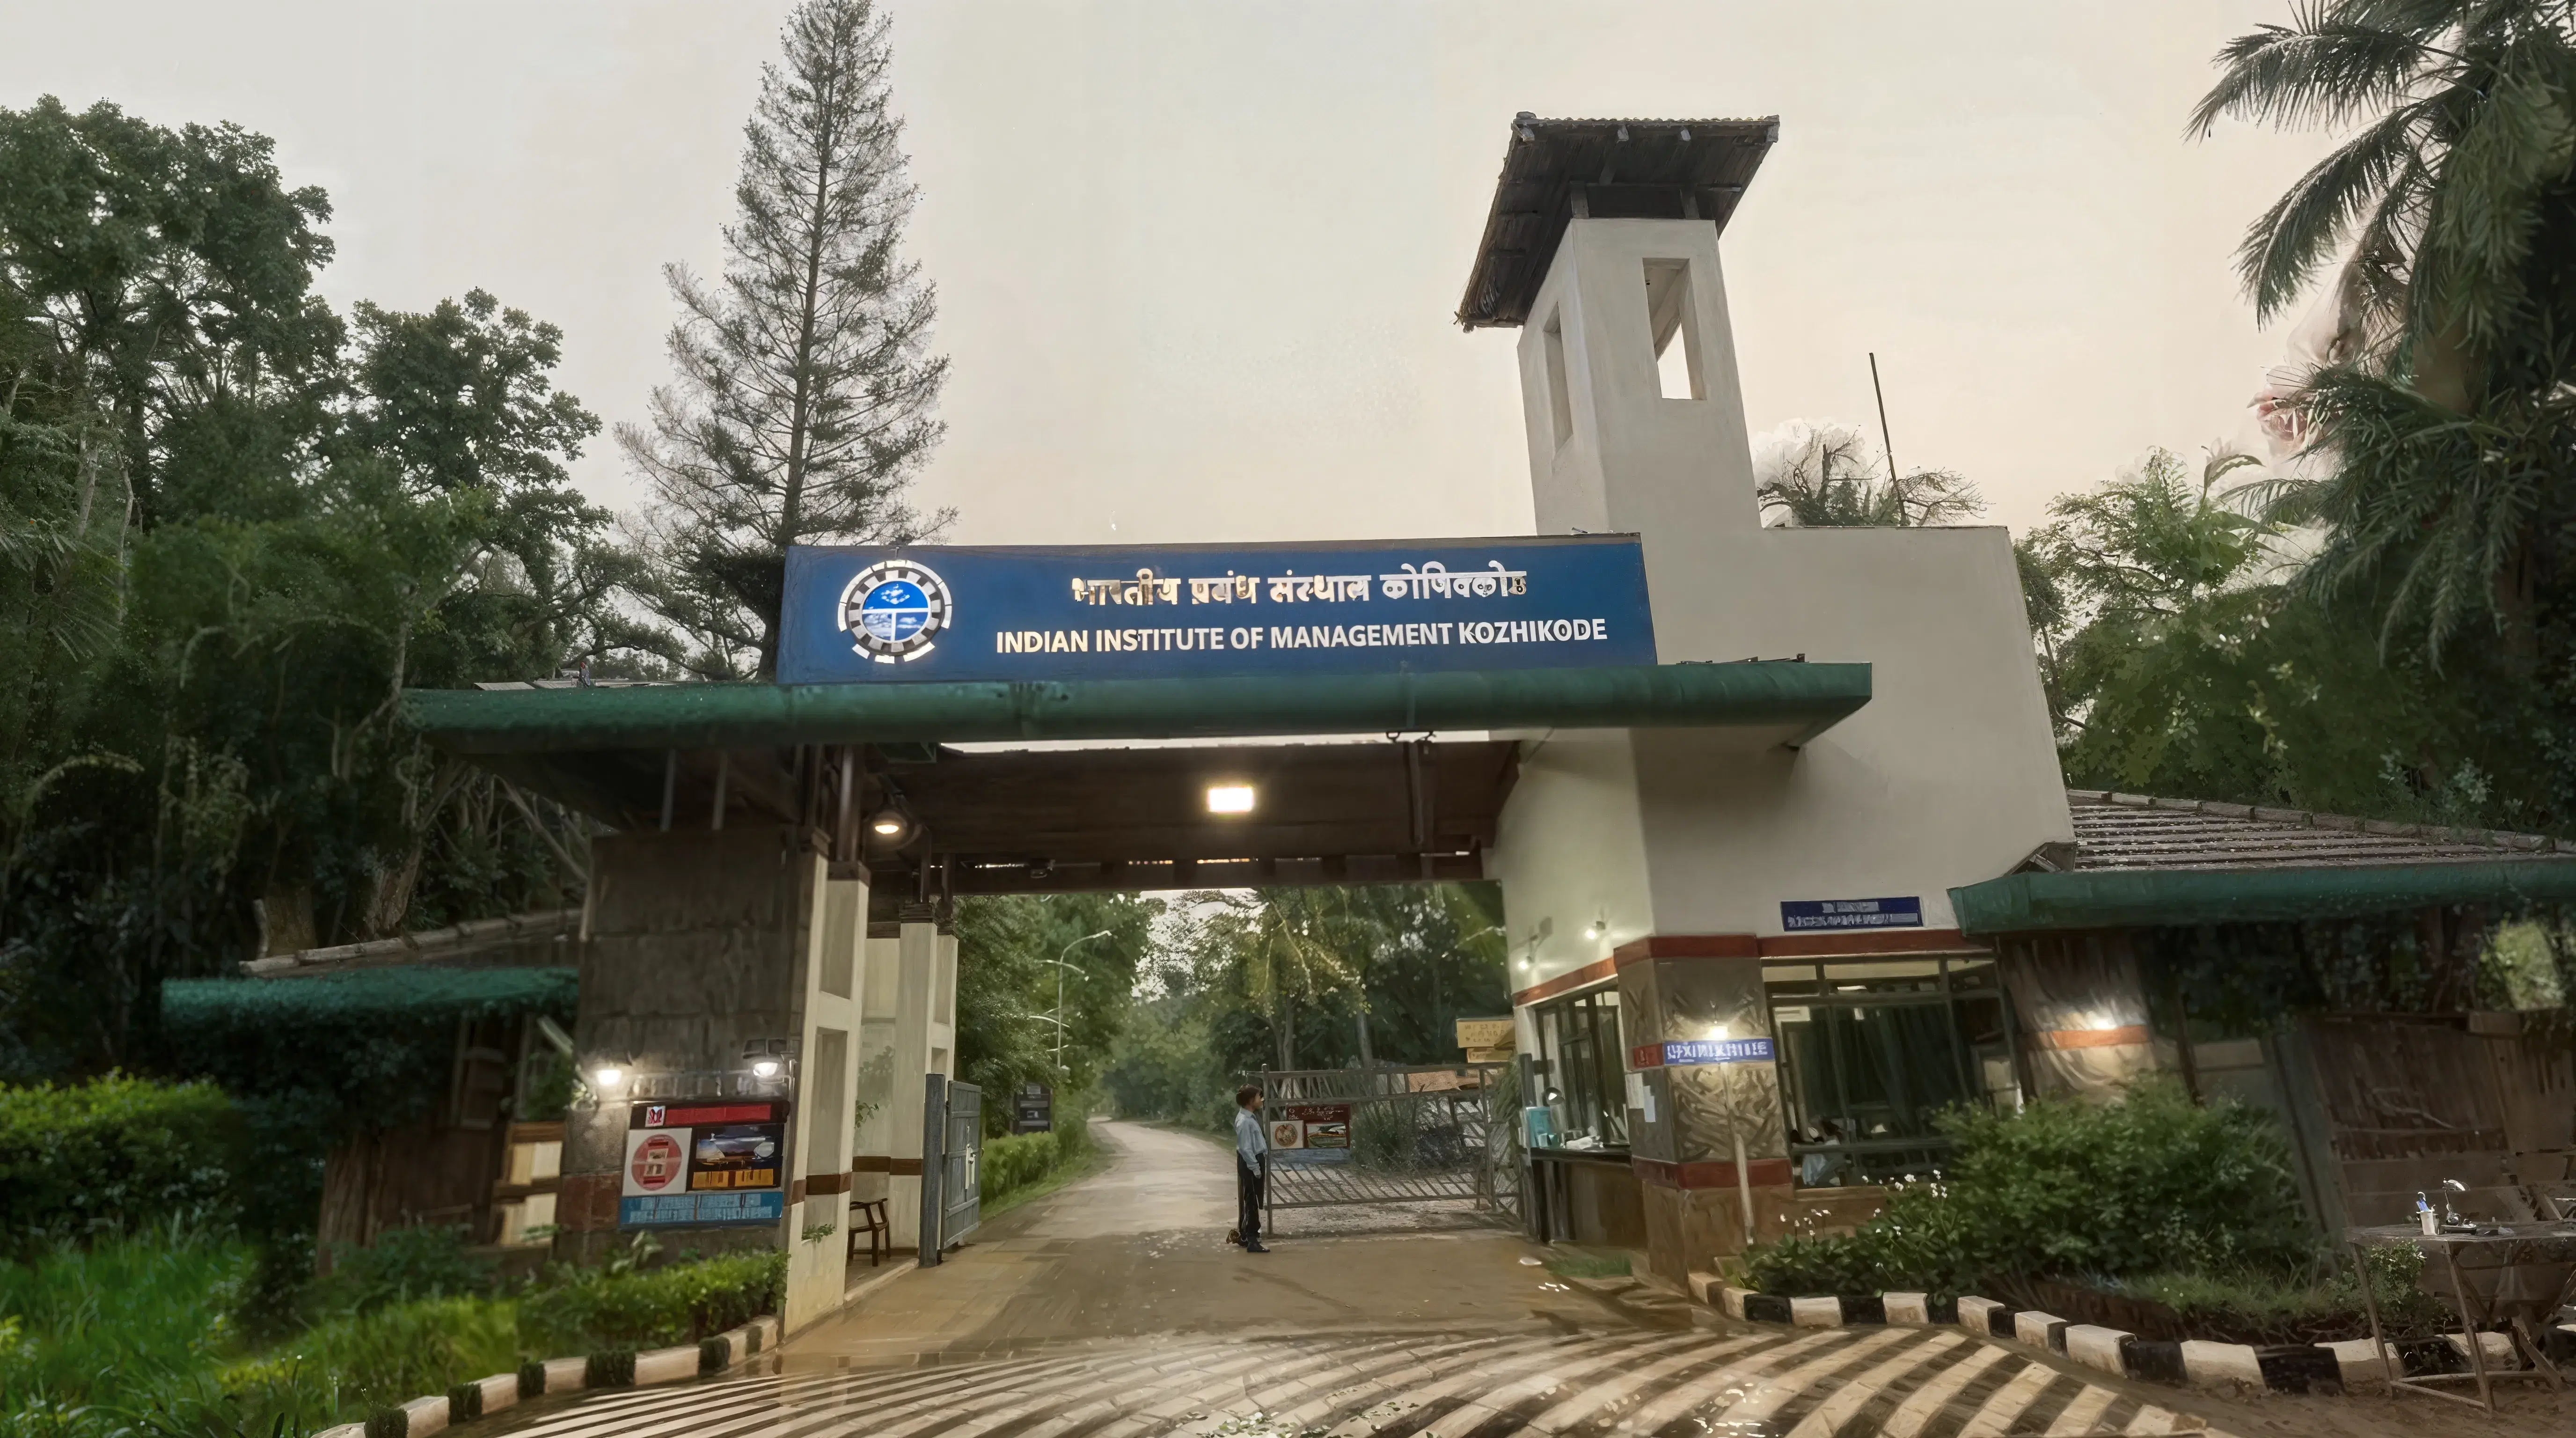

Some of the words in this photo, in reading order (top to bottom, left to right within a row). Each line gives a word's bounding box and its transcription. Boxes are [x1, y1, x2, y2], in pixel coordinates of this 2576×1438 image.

[997, 630, 1088, 653] INDIAN
[1096, 628, 1224, 652] INSTITUTE
[1231, 627, 1263, 649] OF
[1271, 623, 1453, 648] MANAGEMENT
[1459, 618, 1607, 644] KOZHIKODE
